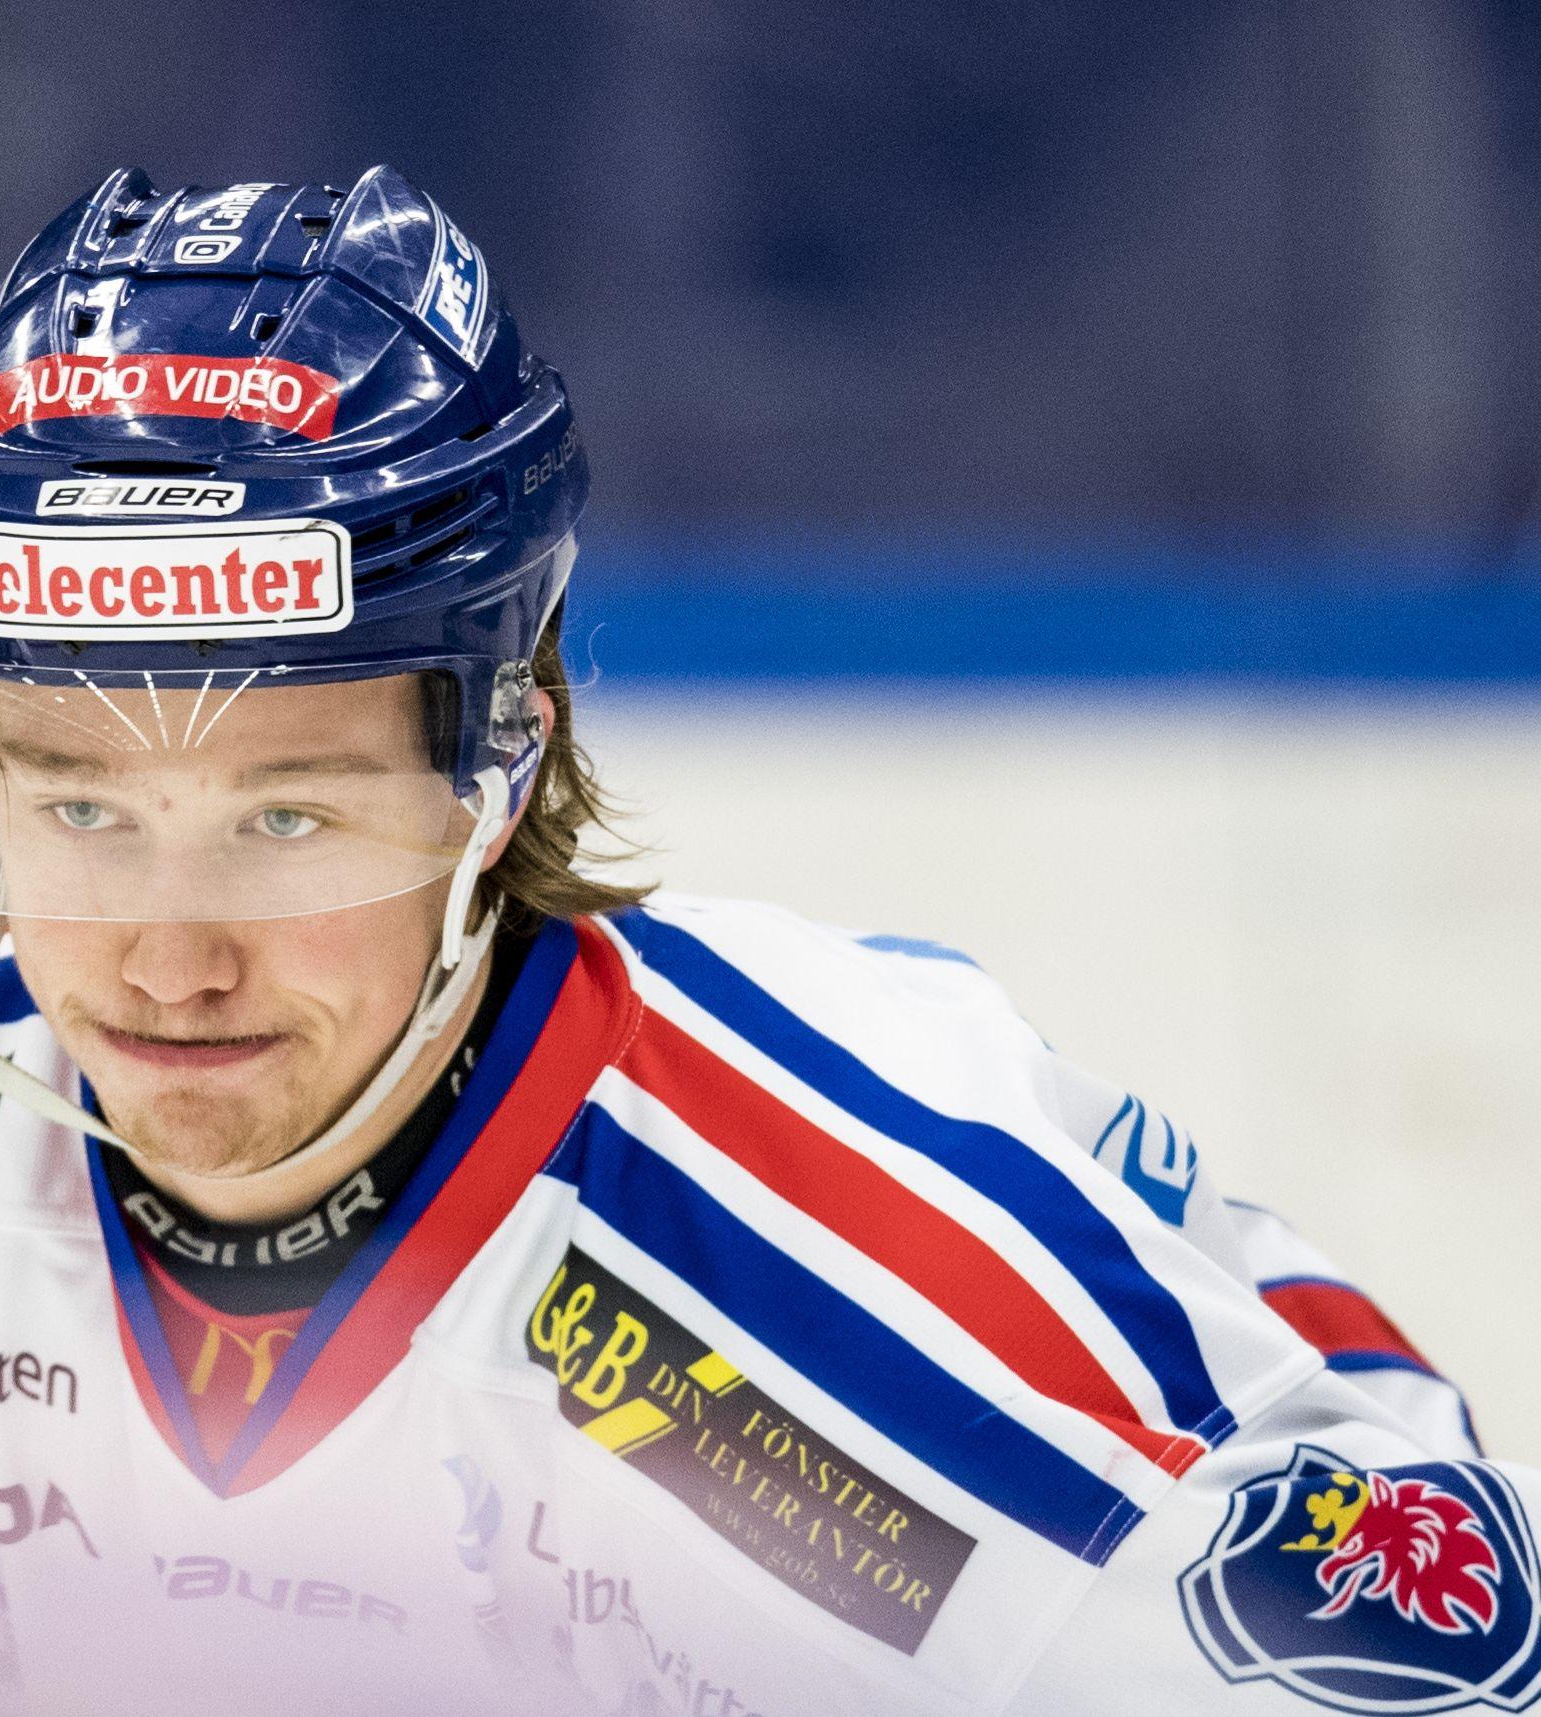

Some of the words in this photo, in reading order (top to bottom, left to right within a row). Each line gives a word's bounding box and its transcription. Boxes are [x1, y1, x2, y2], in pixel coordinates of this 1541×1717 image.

[8, 365, 150, 415] AUDIO
[164, 365, 304, 415] VIDEO
[530, 1262, 650, 1410] G&B
[646, 1363, 710, 1424] DIN
[742, 1409, 910, 1543] FÖNSTER
[695, 1428, 932, 1612] LEVERANTÖR
